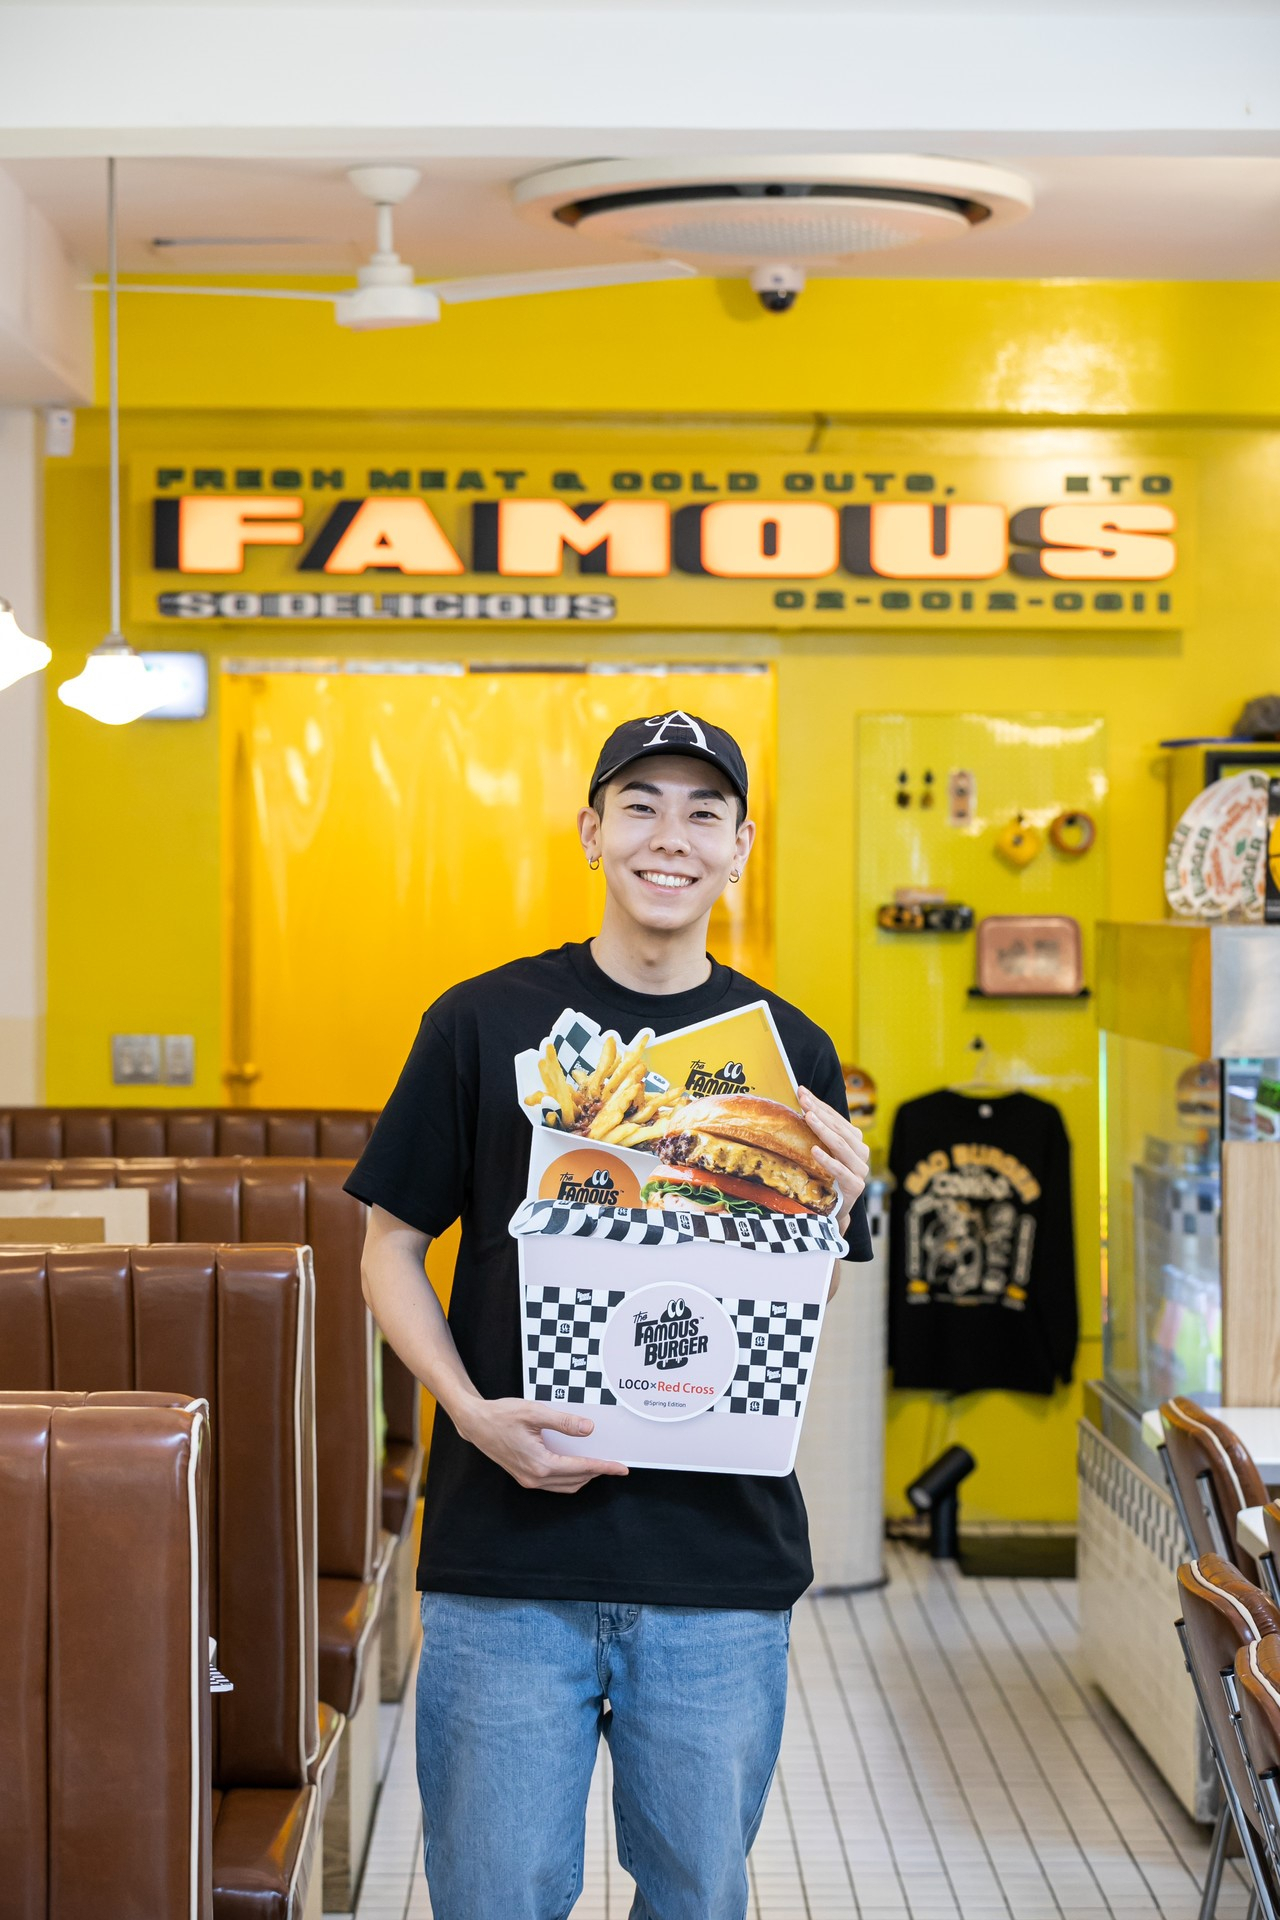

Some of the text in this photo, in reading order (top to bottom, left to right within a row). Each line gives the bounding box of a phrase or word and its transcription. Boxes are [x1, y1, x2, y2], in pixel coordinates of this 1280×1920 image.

[369, 469, 527, 491] MEAT
[156, 496, 1177, 580] FAMOUS
[278, 592, 617, 620] DELICIOUS
[690, 1060, 706, 1070] The
[560, 1172, 574, 1181] The
[557, 1182, 620, 1206] FAMOUS
[633, 1311, 648, 1324] The
[634, 1318, 700, 1347] FAMOUS
[644, 1335, 709, 1366] BURGER
[682, 1382, 715, 1395] Cross
[667, 1400, 687, 1408] Edition
